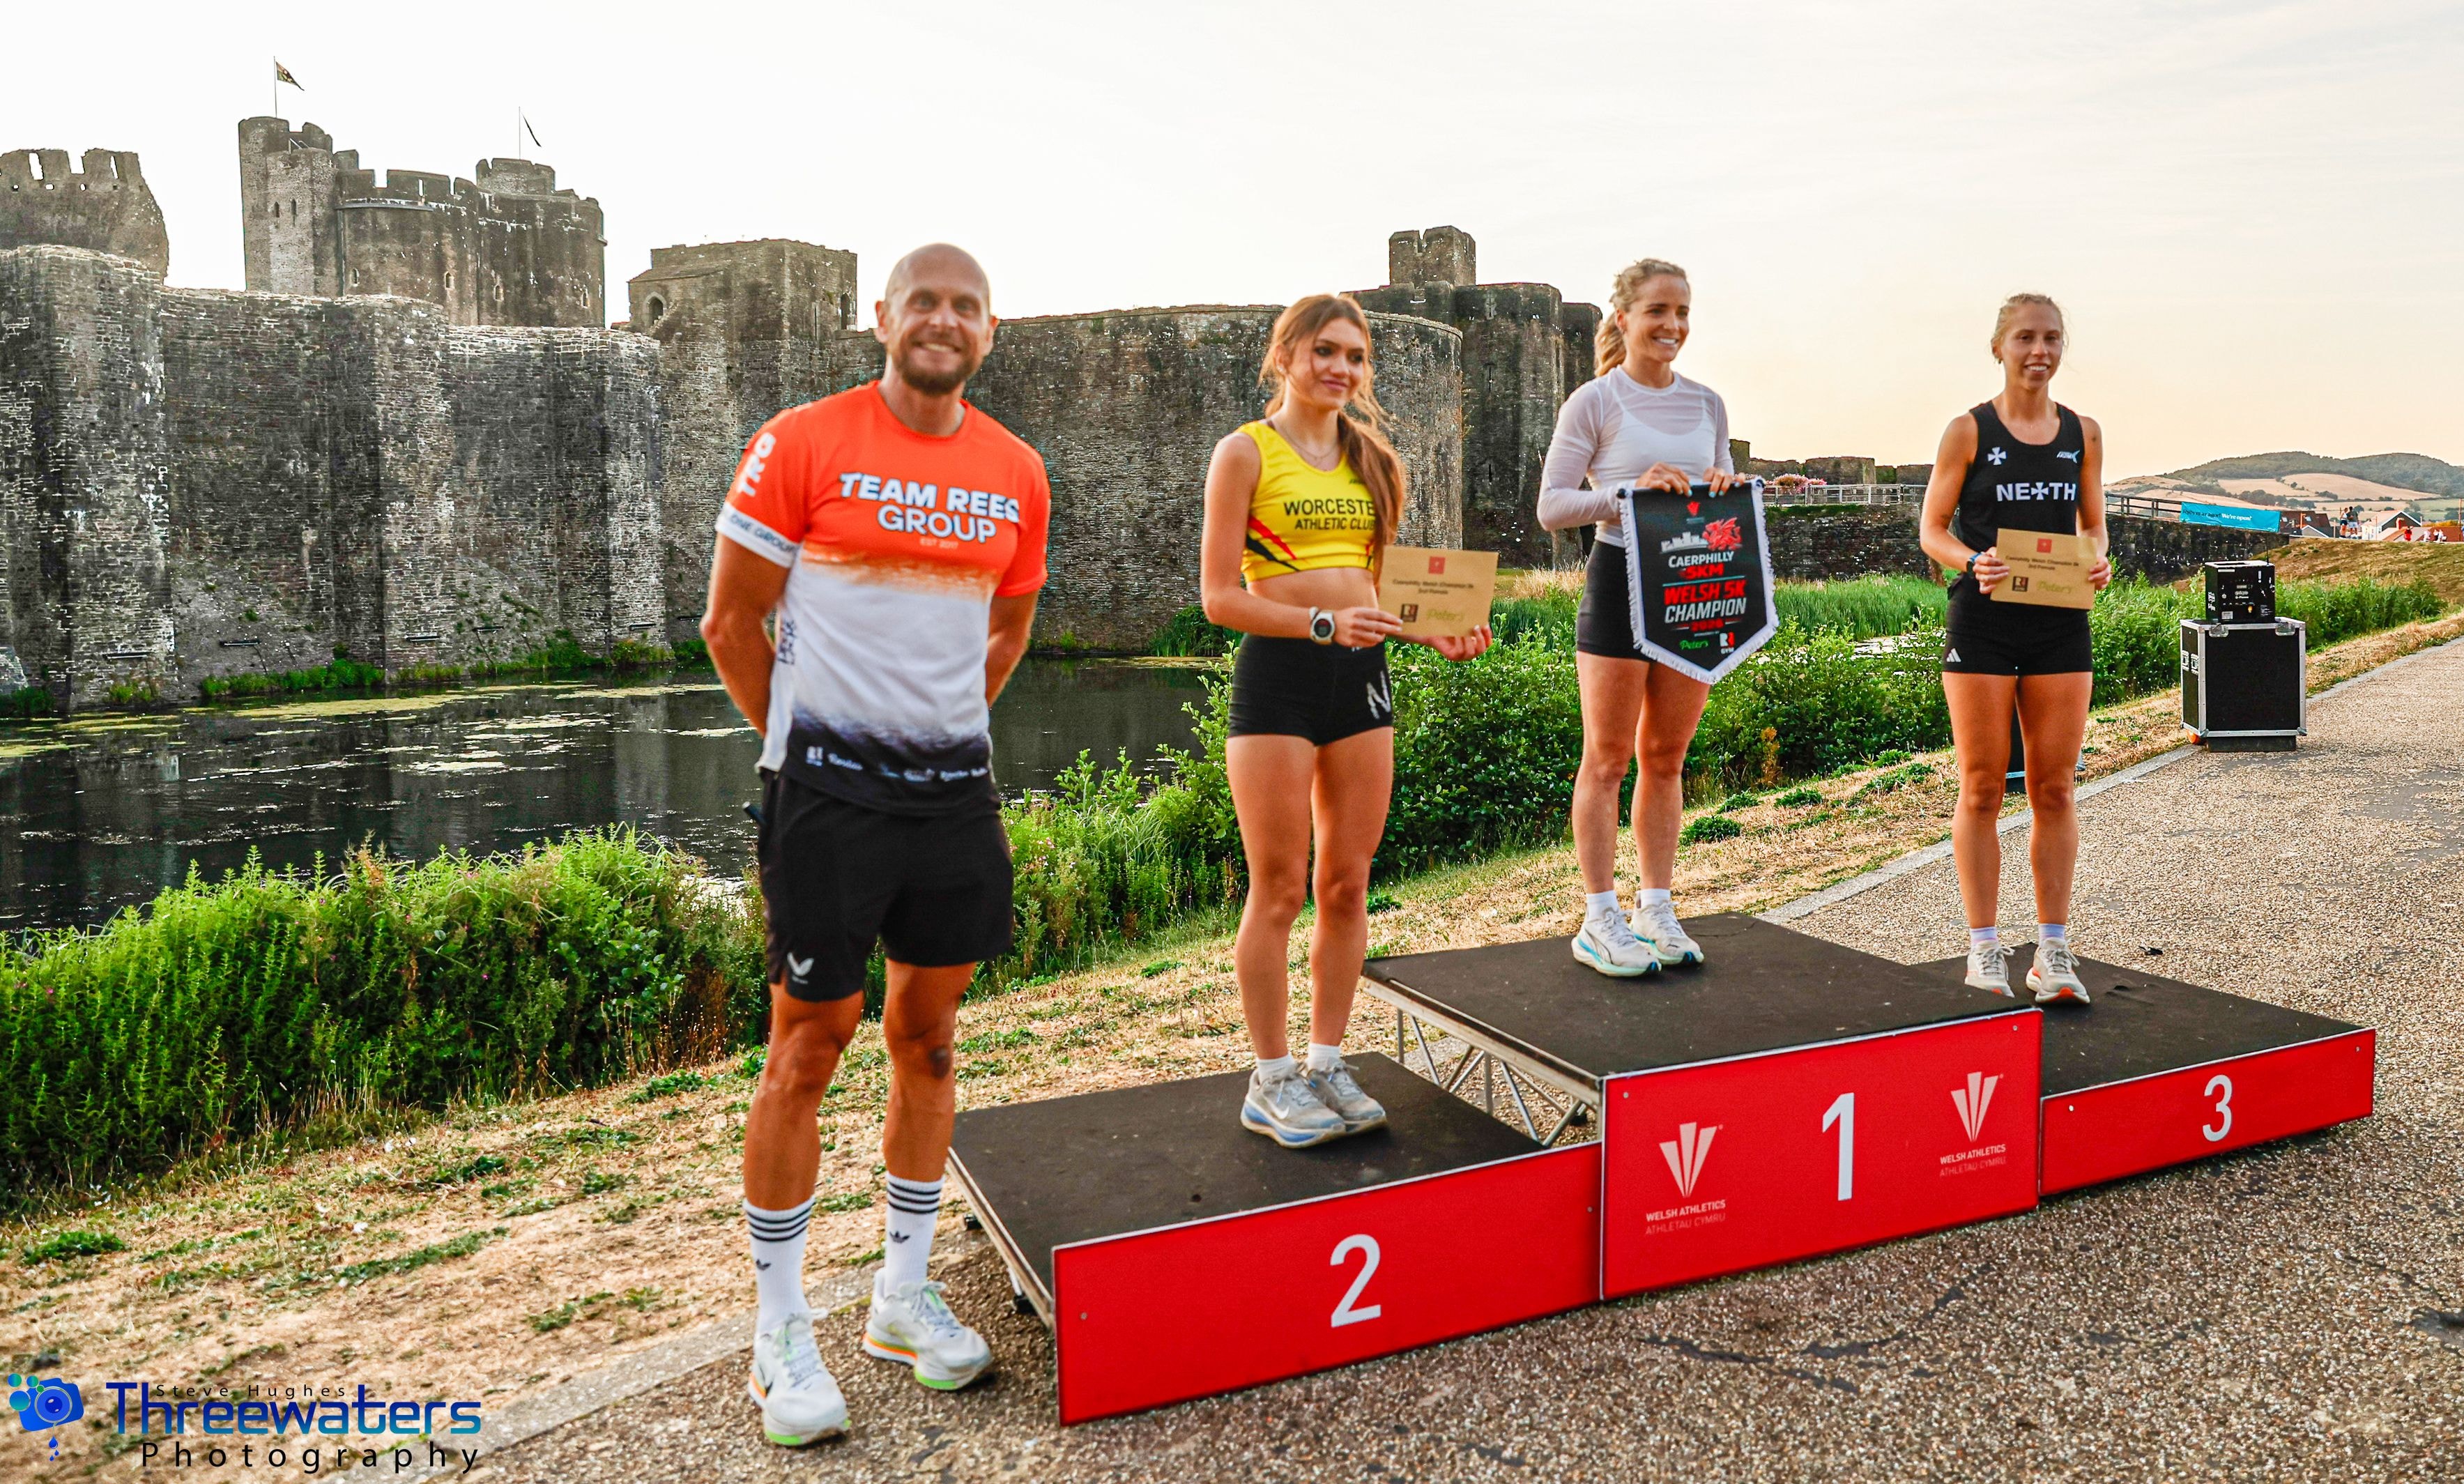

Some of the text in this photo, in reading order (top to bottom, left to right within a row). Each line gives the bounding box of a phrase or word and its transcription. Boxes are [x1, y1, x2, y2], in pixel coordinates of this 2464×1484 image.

[839, 472, 1020, 523] TEAM REES
[1284, 498, 1376, 516] WORCESTE
[877, 504, 997, 544] GROUP
[1294, 517, 1375, 530] ATHLETIC CLUB
[1668, 551, 1735, 568] CAERPHILLY
[1685, 563, 1724, 580] 5KM
[1664, 579, 1747, 606] WELSH 5K
[1665, 597, 1747, 624] CHAMPION
[2203, 1074, 2233, 1142] 3
[1821, 1092, 1855, 1201] 1
[1940, 1144, 2006, 1165] WELSH ATHLETICS
[1940, 1156, 2007, 1177] ATHLETAU CYMRU
[1646, 1199, 1726, 1222] WELSH ATHLETICS
[1645, 1212, 1727, 1235] ATHLETAU CYMRU
[1330, 1234, 1382, 1328] 2
